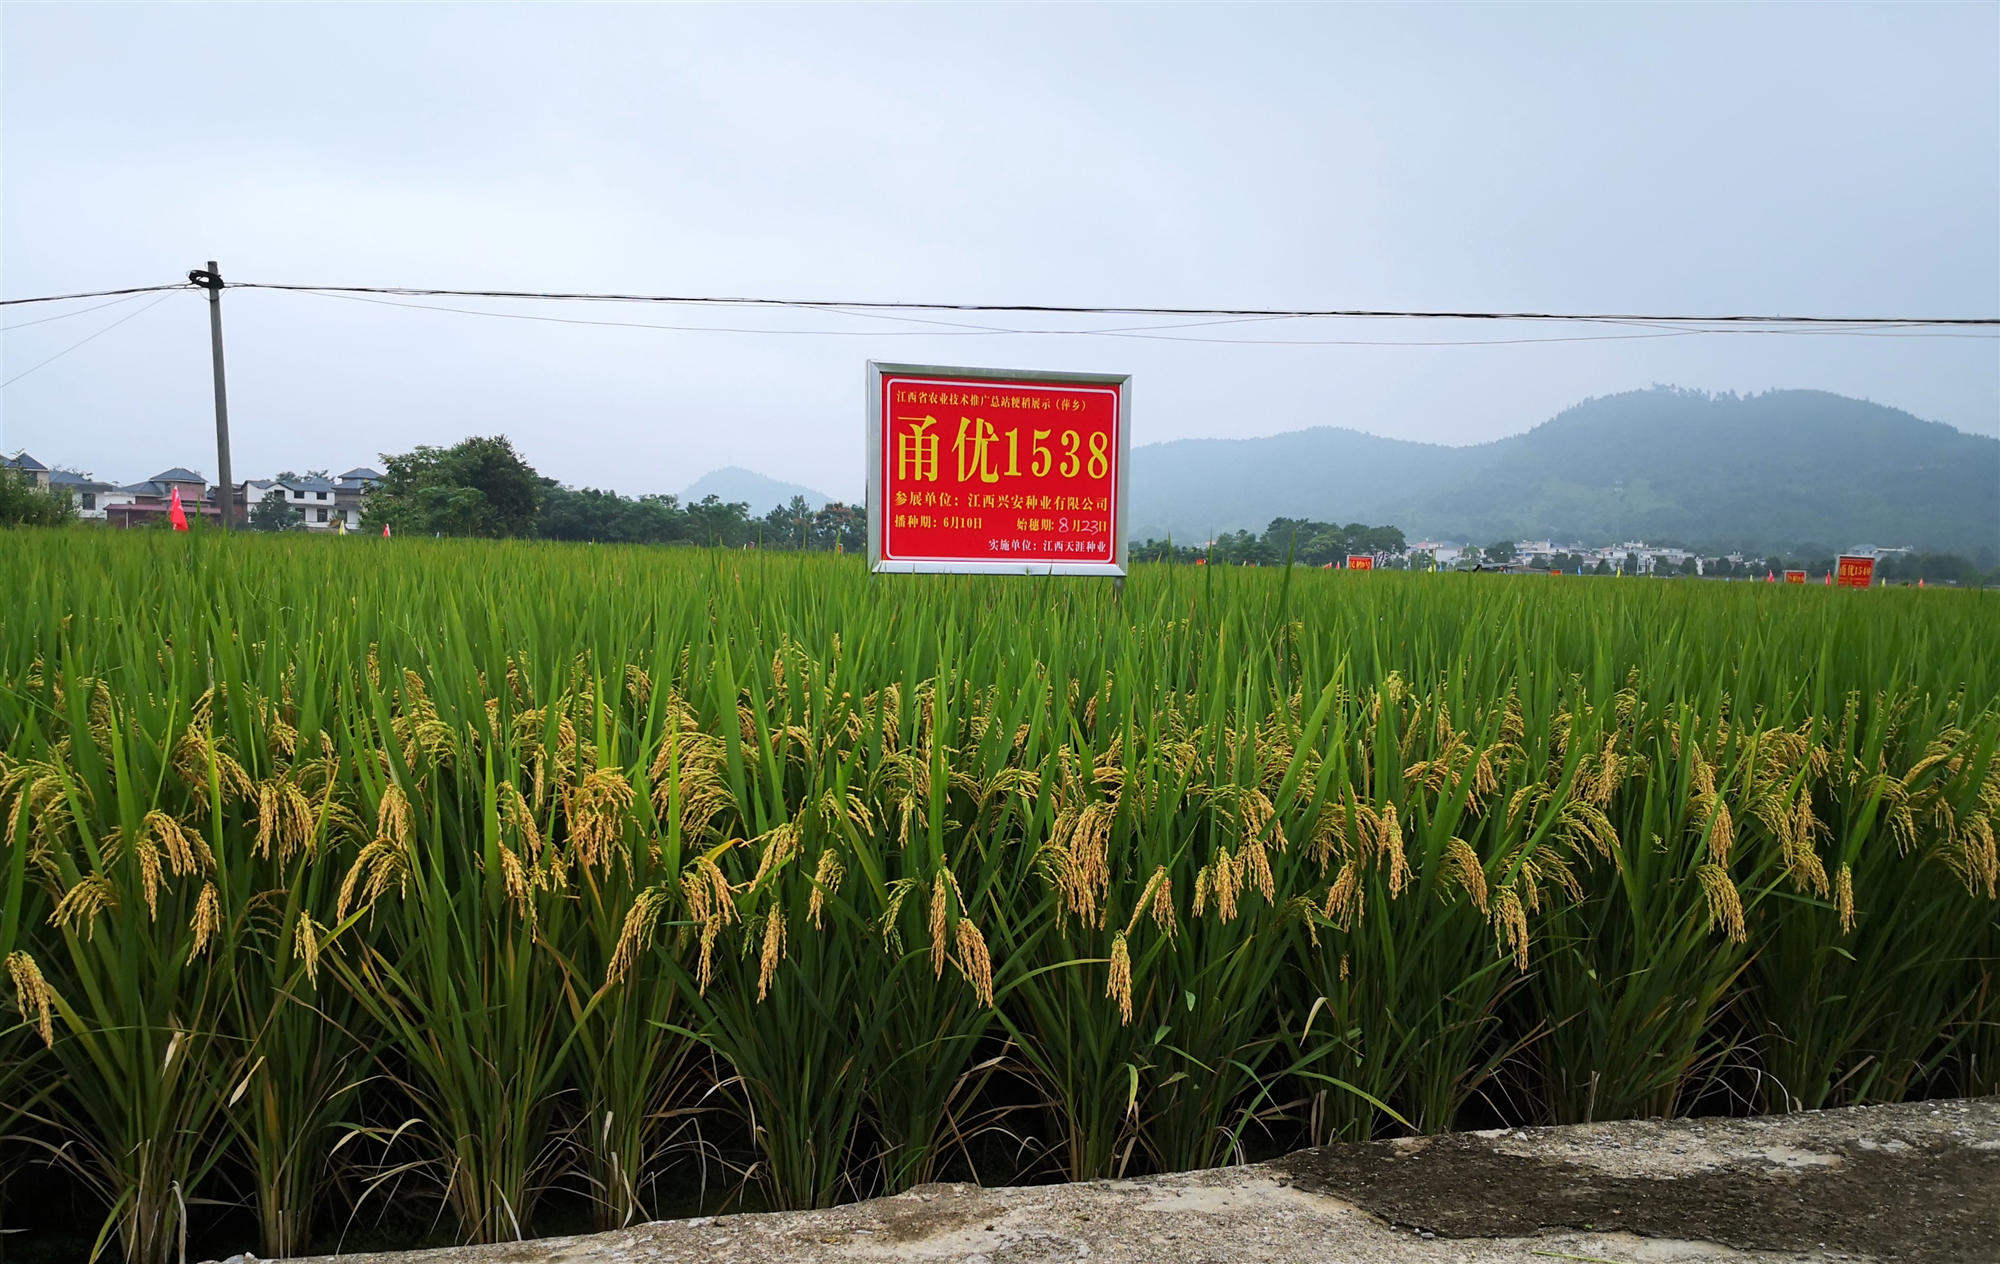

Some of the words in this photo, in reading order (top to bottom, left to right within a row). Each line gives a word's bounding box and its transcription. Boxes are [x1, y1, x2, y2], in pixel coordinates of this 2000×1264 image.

[897, 415, 1108, 482] 甬优1538
[895, 490, 1108, 511] 参展单位：江西兴安种业有限公司
[894, 514, 983, 529] 播种期：6月10日
